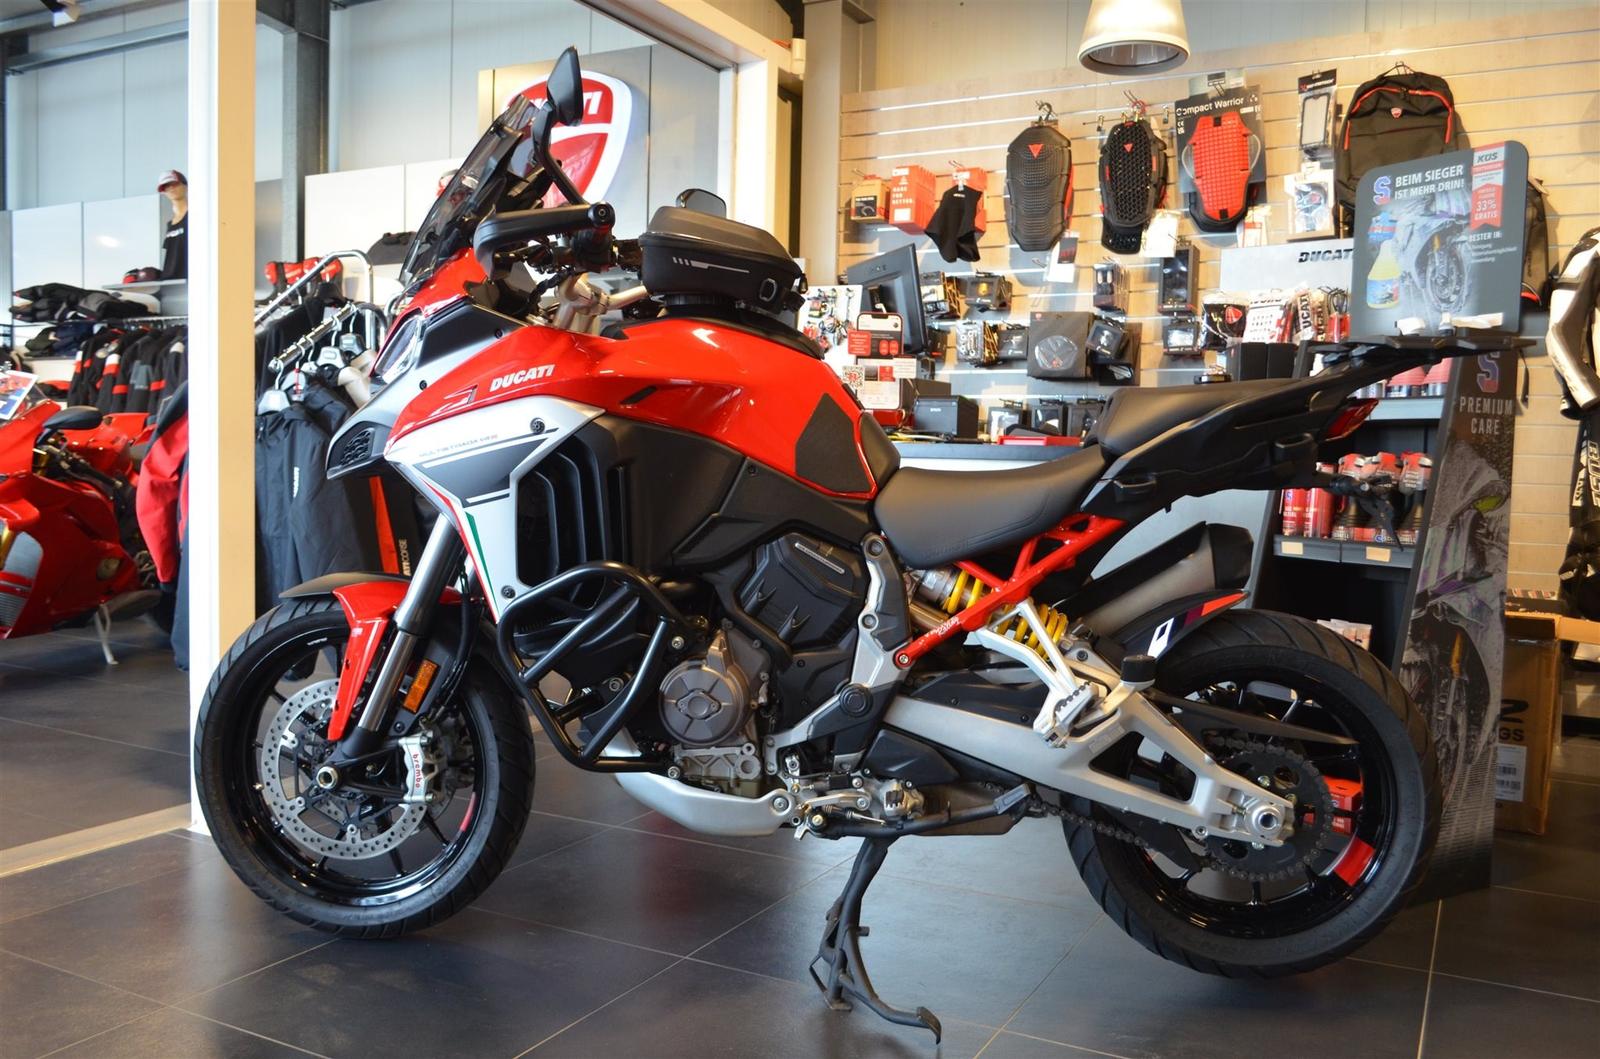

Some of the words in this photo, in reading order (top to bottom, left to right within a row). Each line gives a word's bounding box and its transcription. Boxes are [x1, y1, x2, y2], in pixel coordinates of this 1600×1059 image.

[1176, 102, 1213, 116] Compact
[1214, 97, 1244, 109] Warrior
[1395, 172, 1422, 188] BEIM
[1425, 164, 1464, 182] SIEGER
[1394, 189, 1410, 200] IST
[1410, 186, 1436, 197] MEHR
[1438, 179, 1465, 192] DRIN!
[1476, 199, 1497, 212] 33%
[1298, 248, 1353, 263] DUCAT
[489, 364, 556, 393] DUCATI
[1460, 396, 1513, 415] PREMIUM
[1471, 417, 1501, 435] CARE
[412, 753, 423, 788] brembo
